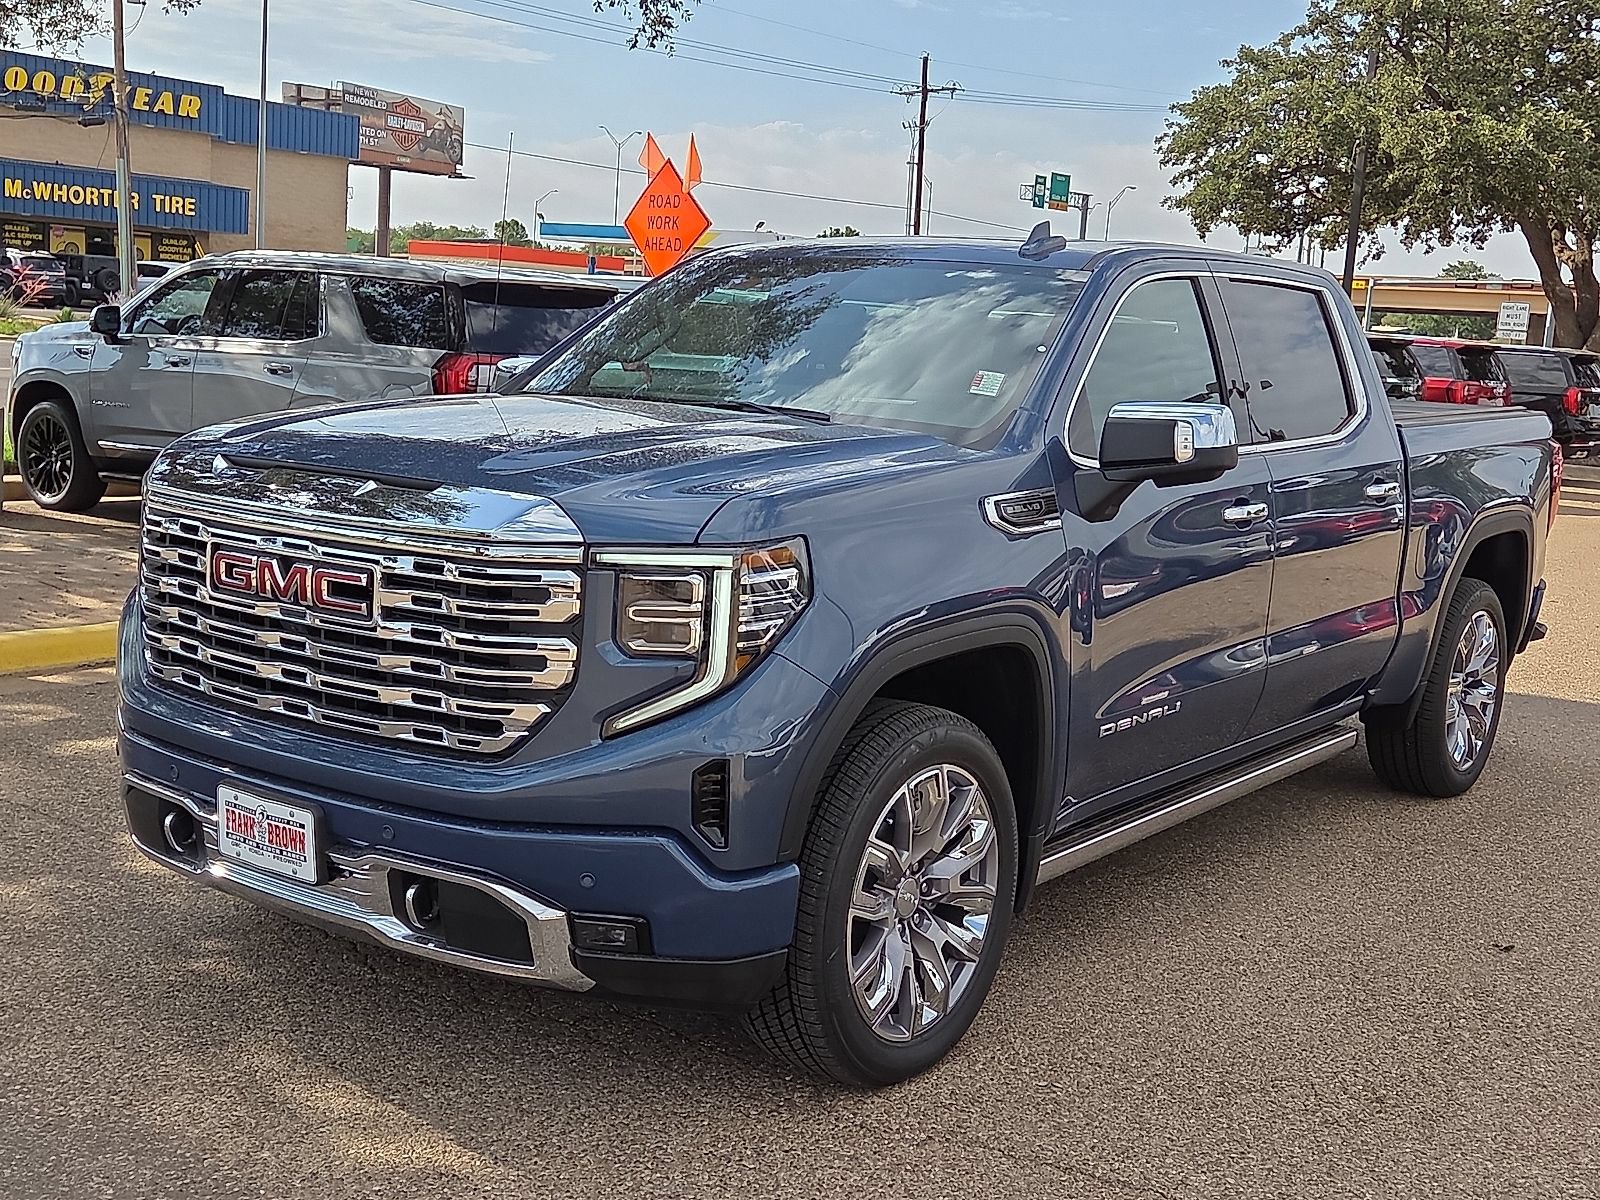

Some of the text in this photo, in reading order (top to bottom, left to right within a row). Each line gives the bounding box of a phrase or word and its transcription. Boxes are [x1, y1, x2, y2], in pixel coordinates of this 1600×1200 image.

[354, 87, 378, 98] NEWLY
[344, 94, 387, 110] REMODELED
[376, 130, 387, 138] ON
[152, 194, 197, 216] TIRE
[648, 195, 681, 209] ROAD
[647, 216, 680, 230] WORK
[158, 245, 192, 254] GOODYEAR
[162, 238, 188, 246] DUNLOP
[644, 237, 682, 252] AHEAD
[213, 550, 367, 616] GMC
[1099, 701, 1182, 738] DENALI
[225, 807, 306, 855] FRANK BROWN
[228, 832, 305, 862] AUTO AND TRUCK RANCH
